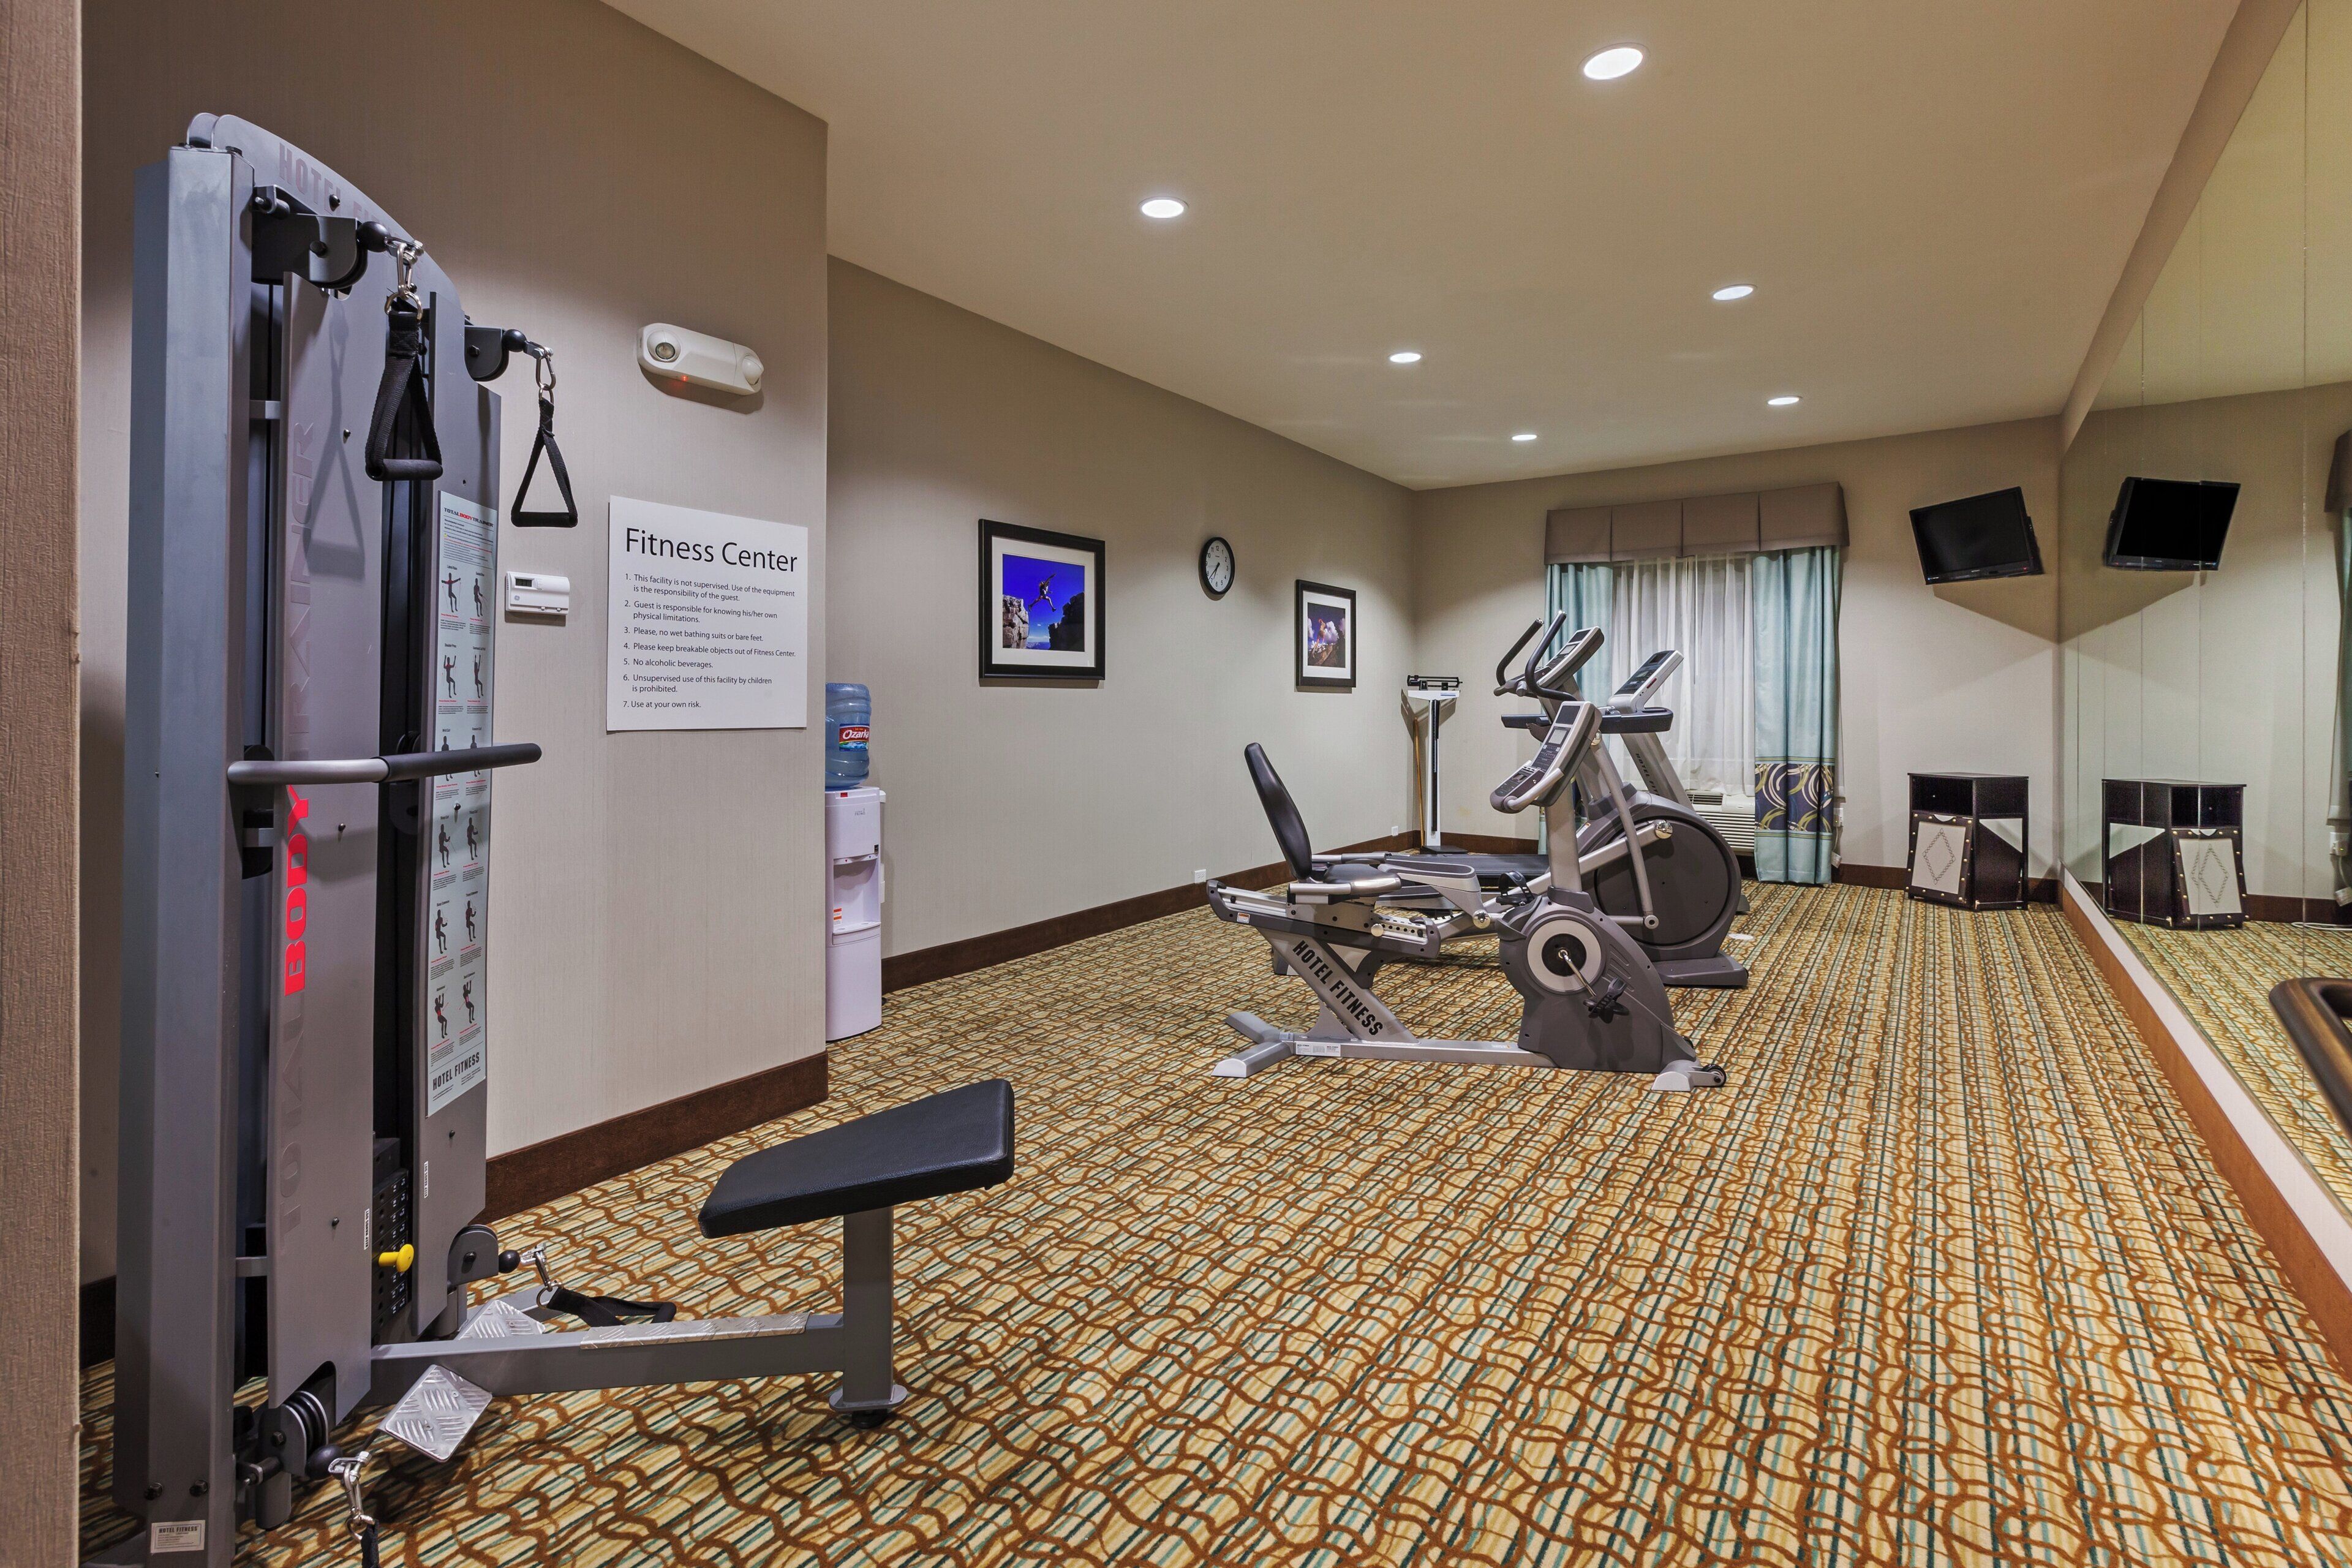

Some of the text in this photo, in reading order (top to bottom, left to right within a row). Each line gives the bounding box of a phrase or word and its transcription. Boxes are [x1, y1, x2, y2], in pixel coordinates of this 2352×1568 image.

[626, 527, 798, 572] Fitness Center
[625, 573, 632, 581] 1.
[633, 573, 649, 583] This
[649, 575, 673, 586] facility
[693, 581, 731, 592] supervised.
[731, 584, 743, 592] Use
[763, 588, 795, 597] equipment
[633, 584, 641, 592] is
[640, 585, 653, 594] the
[654, 587, 699, 599] responsibility
[708, 590, 720, 600] the
[633, 600, 655, 610] Guest
[663, 603, 702, 613] responsible
[714, 607, 741, 618] knowing
[742, 609, 764, 618] his/her
[633, 611, 700, 623] physical limitations.
[633, 627, 658, 636] Please,
[684, 630, 710, 640] bathing
[750, 633, 764, 642] feet.
[633, 642, 656, 651] Please
[657, 643, 674, 653] keep
[676, 644, 709, 654] breakable
[709, 646, 734, 655] objects
[644, 658, 676, 667] alcoholic
[677, 659, 714, 669] beverages.
[633, 674, 681, 684] Unsupervised
[717, 676, 738, 685] facility
[738, 676, 747, 685] by
[639, 684, 678, 694] prohibited.
[843, 729, 869, 740] Ozarka
[285, 784, 307, 997] BODY
[1292, 940, 1383, 1035] HOTEL FITNESS
[432, 1069, 453, 1091] HOTEL
[454, 1052, 480, 1077] FITNESS
